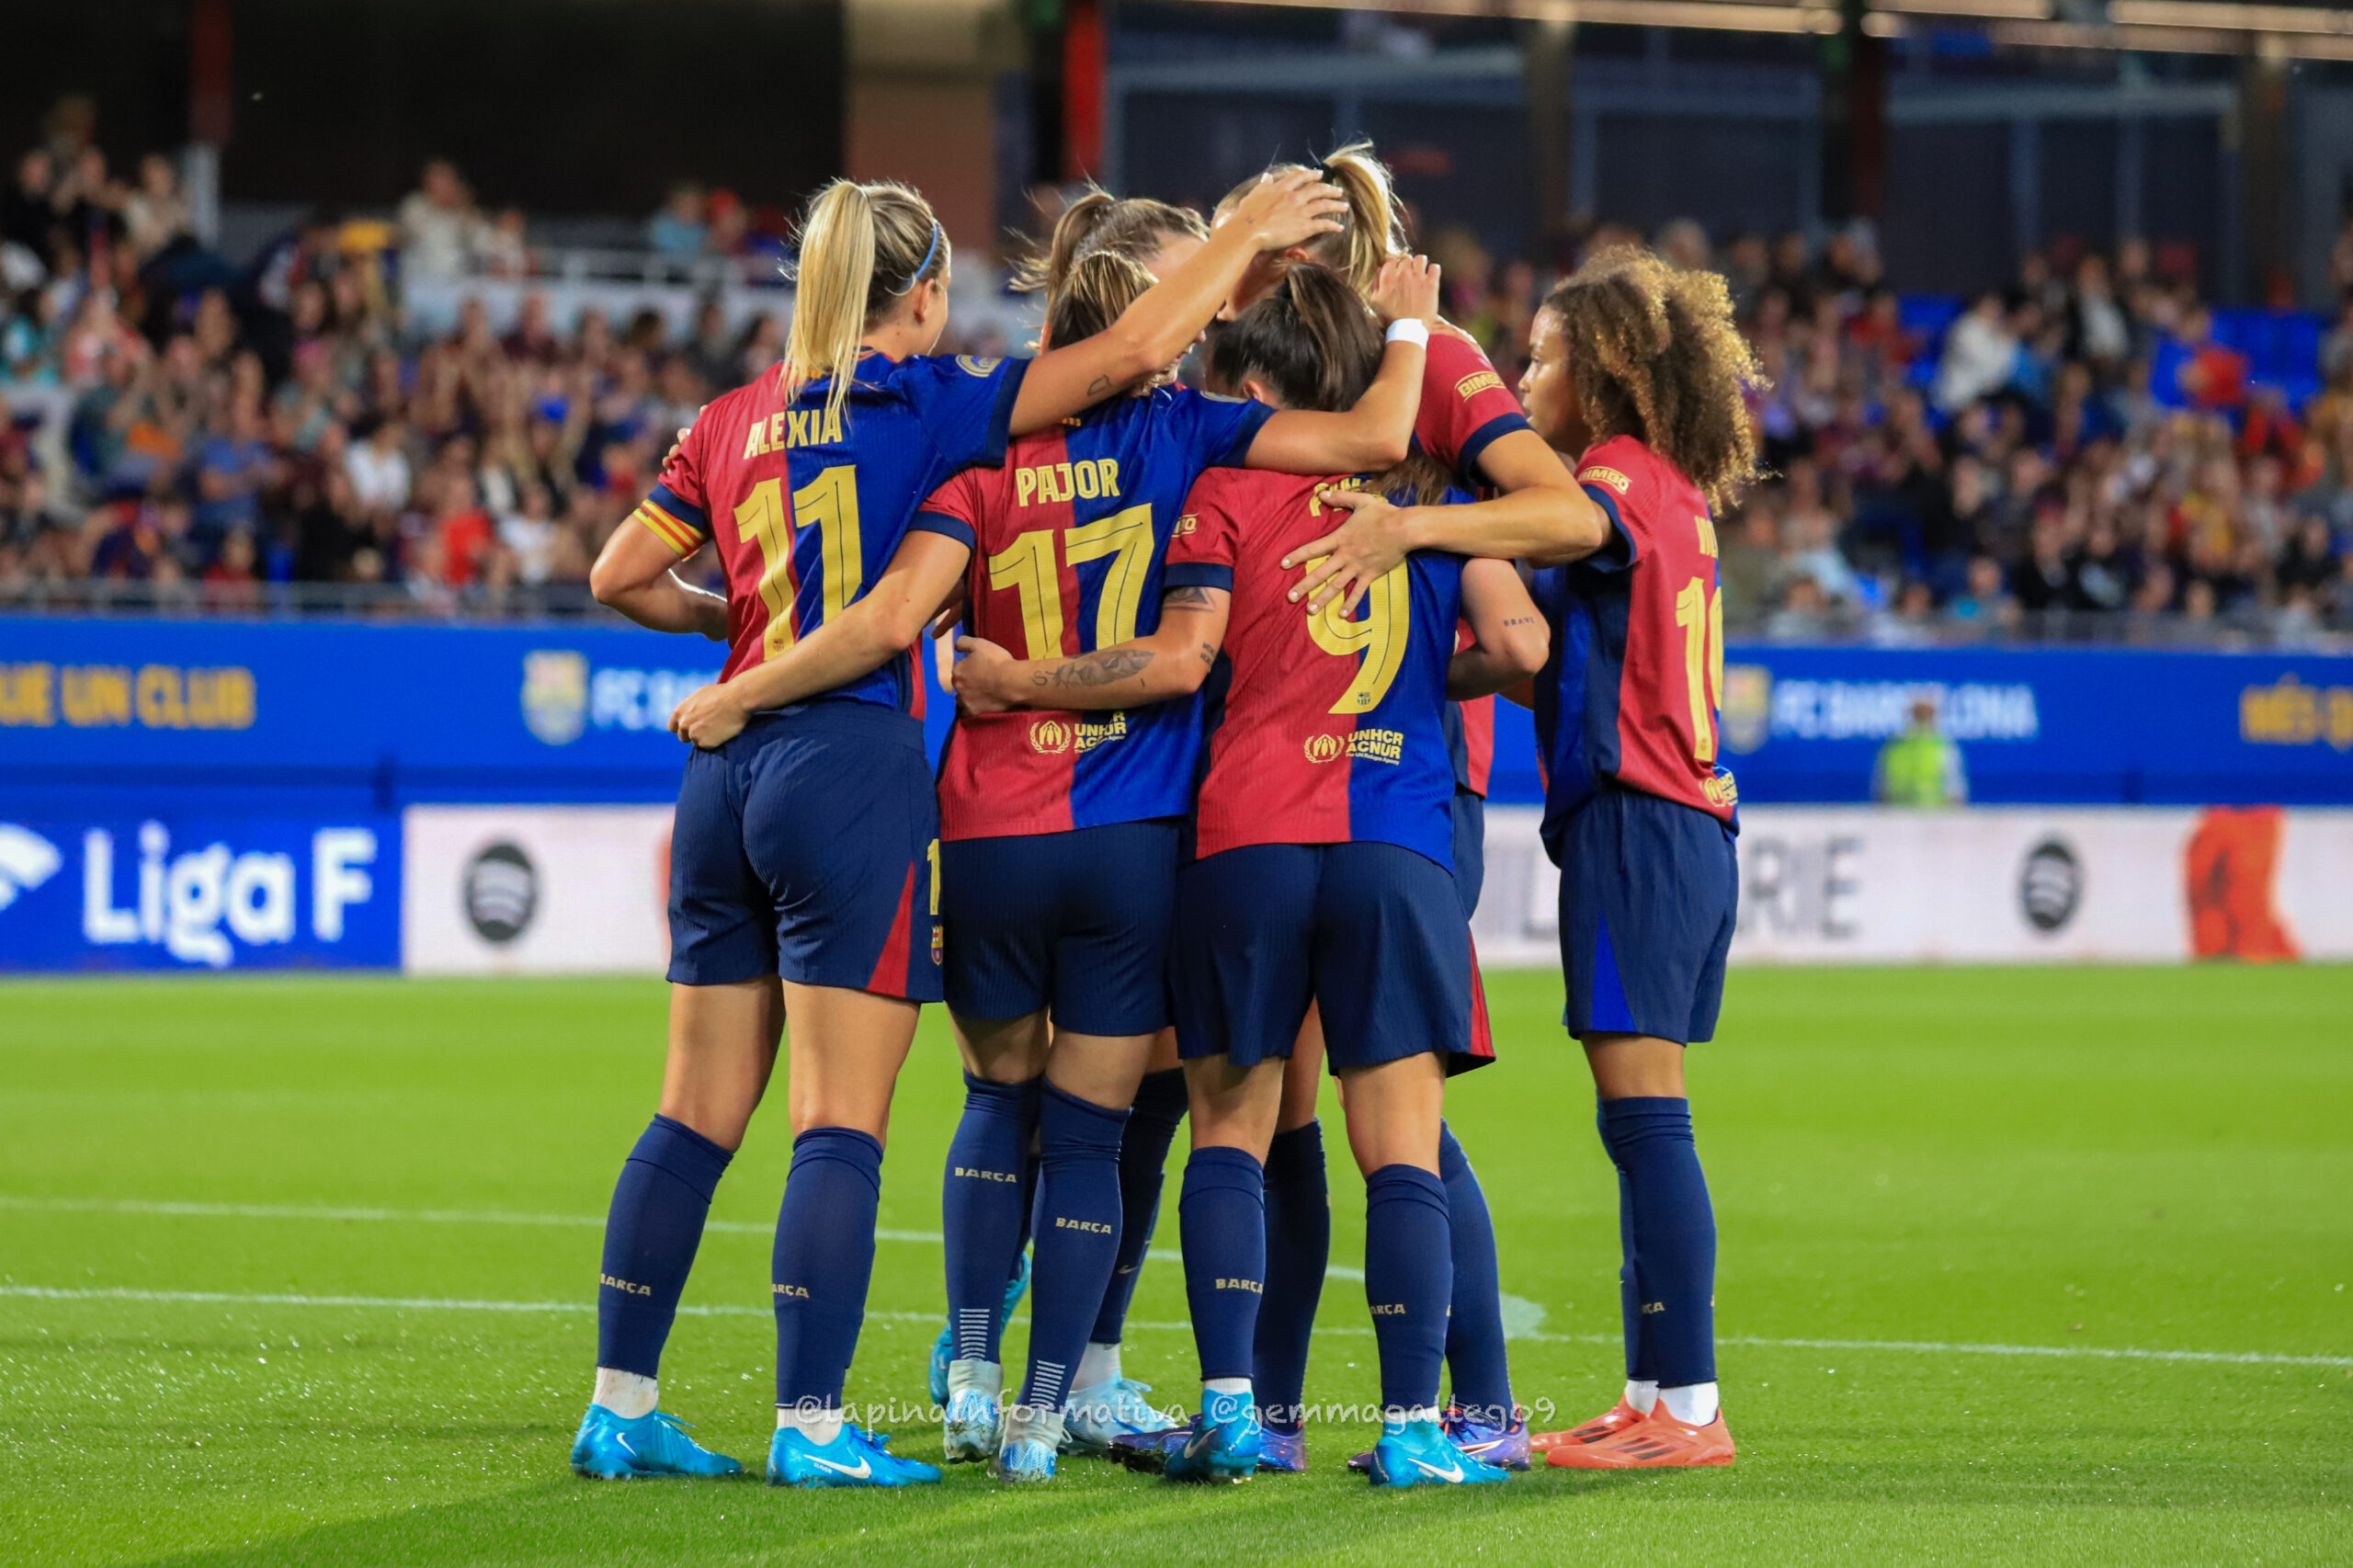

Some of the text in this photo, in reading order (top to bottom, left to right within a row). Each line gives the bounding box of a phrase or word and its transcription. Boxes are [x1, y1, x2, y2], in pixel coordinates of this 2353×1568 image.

[744, 407, 843, 460] ALEXIA
[1015, 458, 1120, 507] PAJOR
[733, 464, 862, 662] 11
[988, 502, 1154, 661] 17
[1305, 551, 1410, 714] 9
[62, 663, 131, 729] UN
[136, 664, 256, 730] CLUB
[1345, 740, 1402, 759] ACNUR
[1347, 728, 1404, 745] UNHCR
[84, 820, 378, 967] Liga F
[926, 838, 941, 915] 1
[954, 1166, 1017, 1184] BARÇA
[1056, 1217, 1112, 1234] BARÇA
